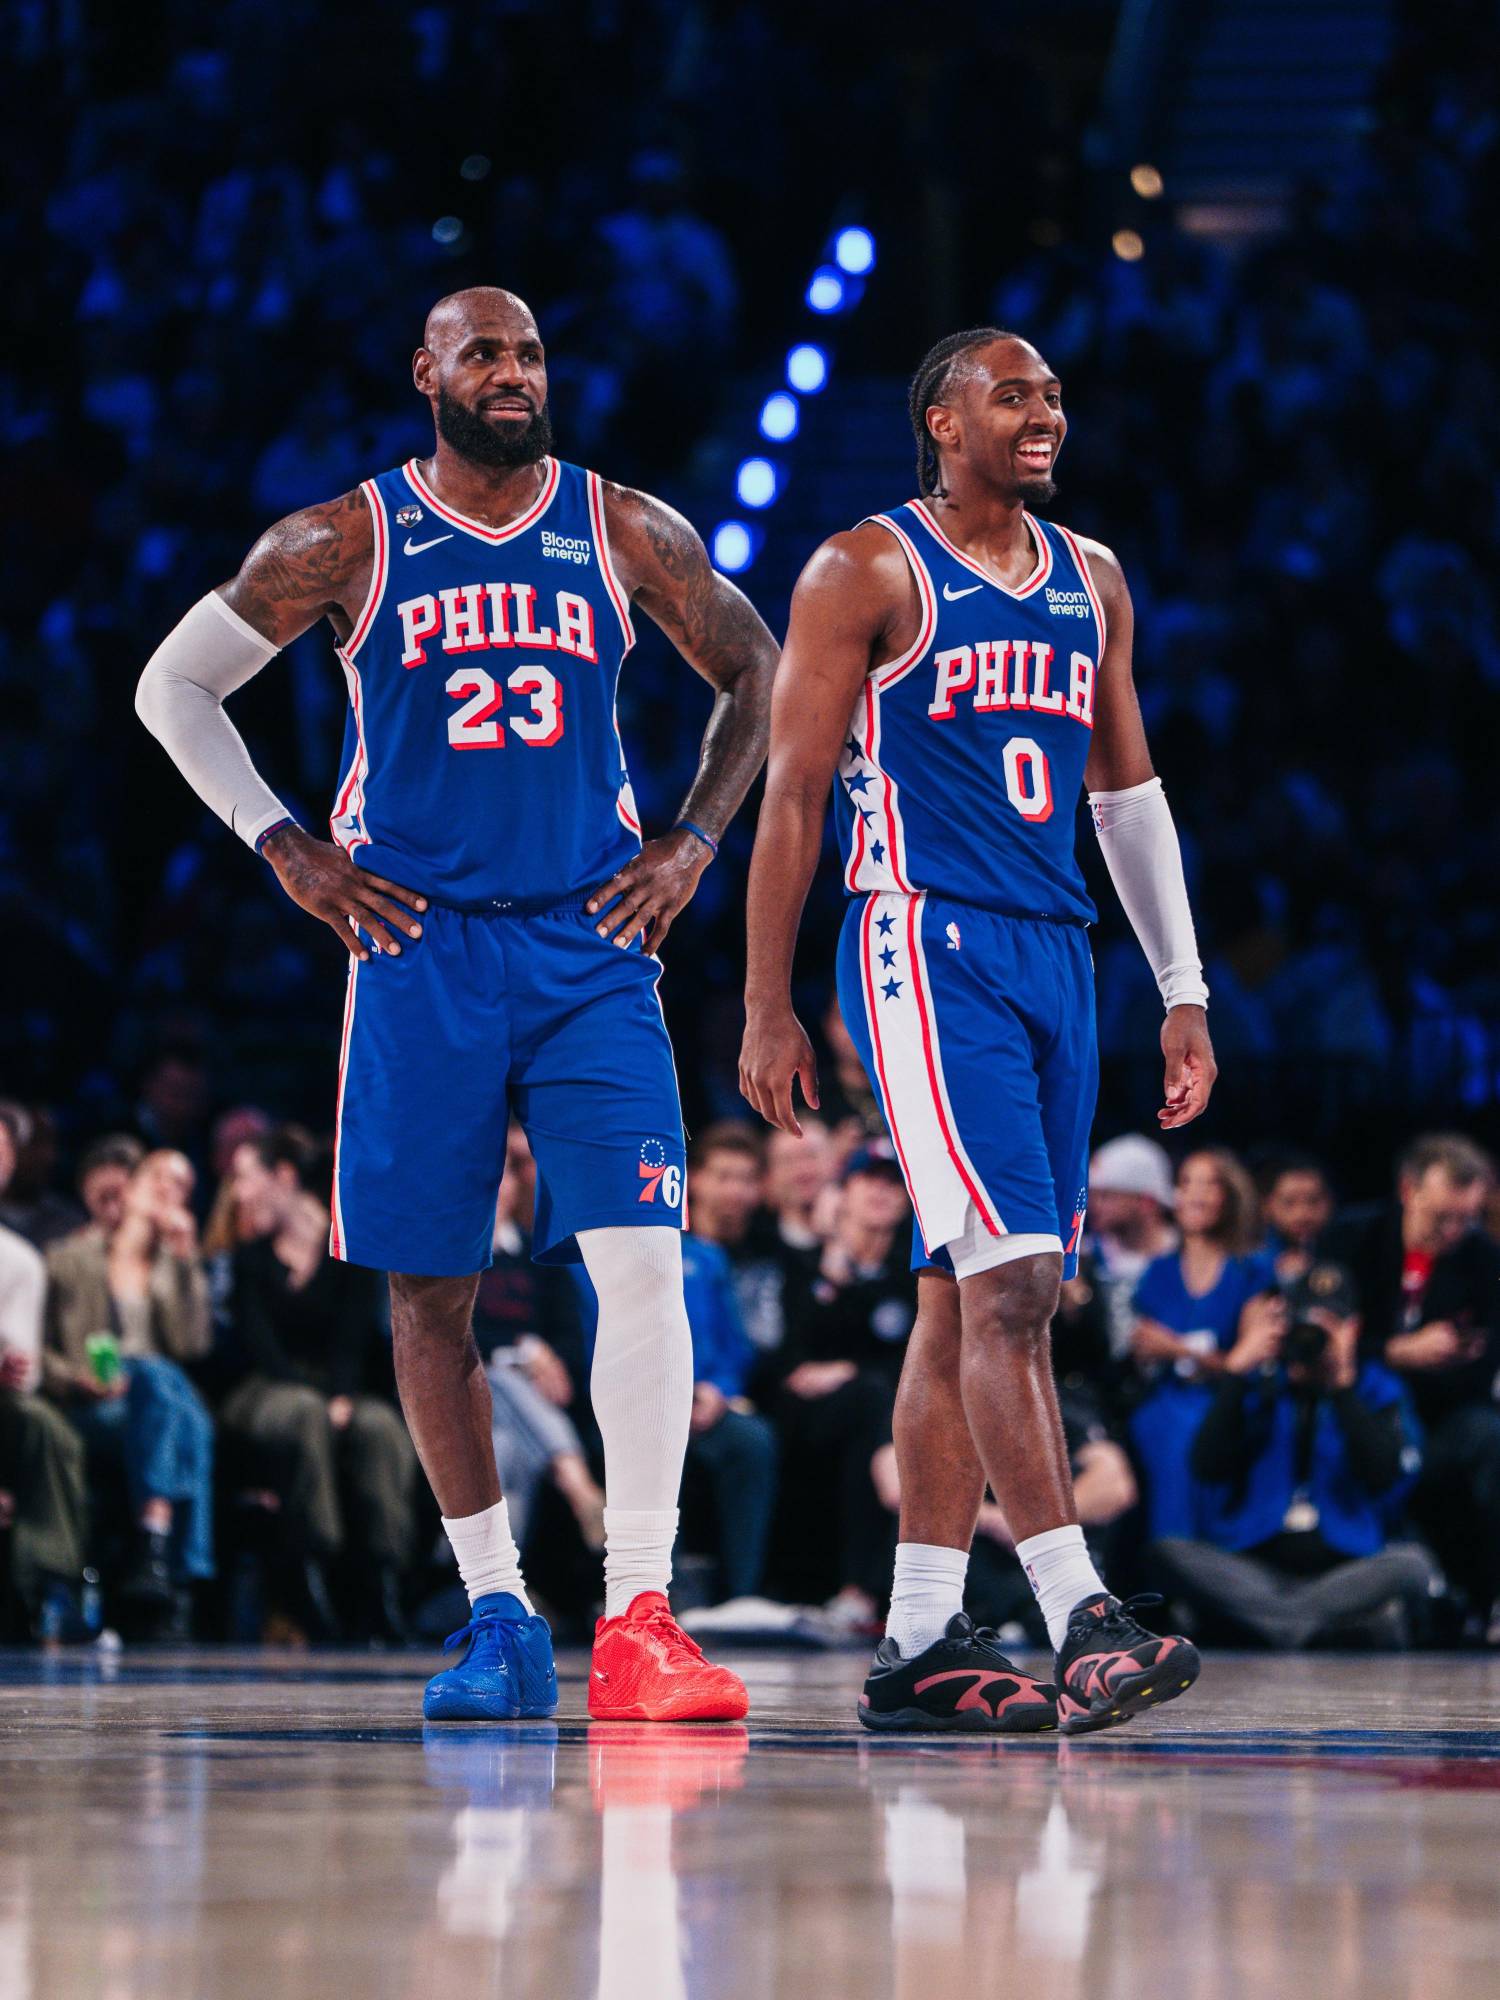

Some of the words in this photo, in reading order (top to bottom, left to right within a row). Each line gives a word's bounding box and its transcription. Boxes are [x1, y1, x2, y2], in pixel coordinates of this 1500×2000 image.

[541, 531, 590, 551] Bloom
[542, 546, 590, 565] energy
[1045, 587, 1088, 604] Bloom
[1049, 604, 1090, 619] energy
[397, 583, 598, 669] PHILA
[445, 666, 564, 750] 23
[928, 640, 1095, 729] PHILA
[1002, 737, 1054, 822] 0
[639, 1160, 680, 1208] 76
